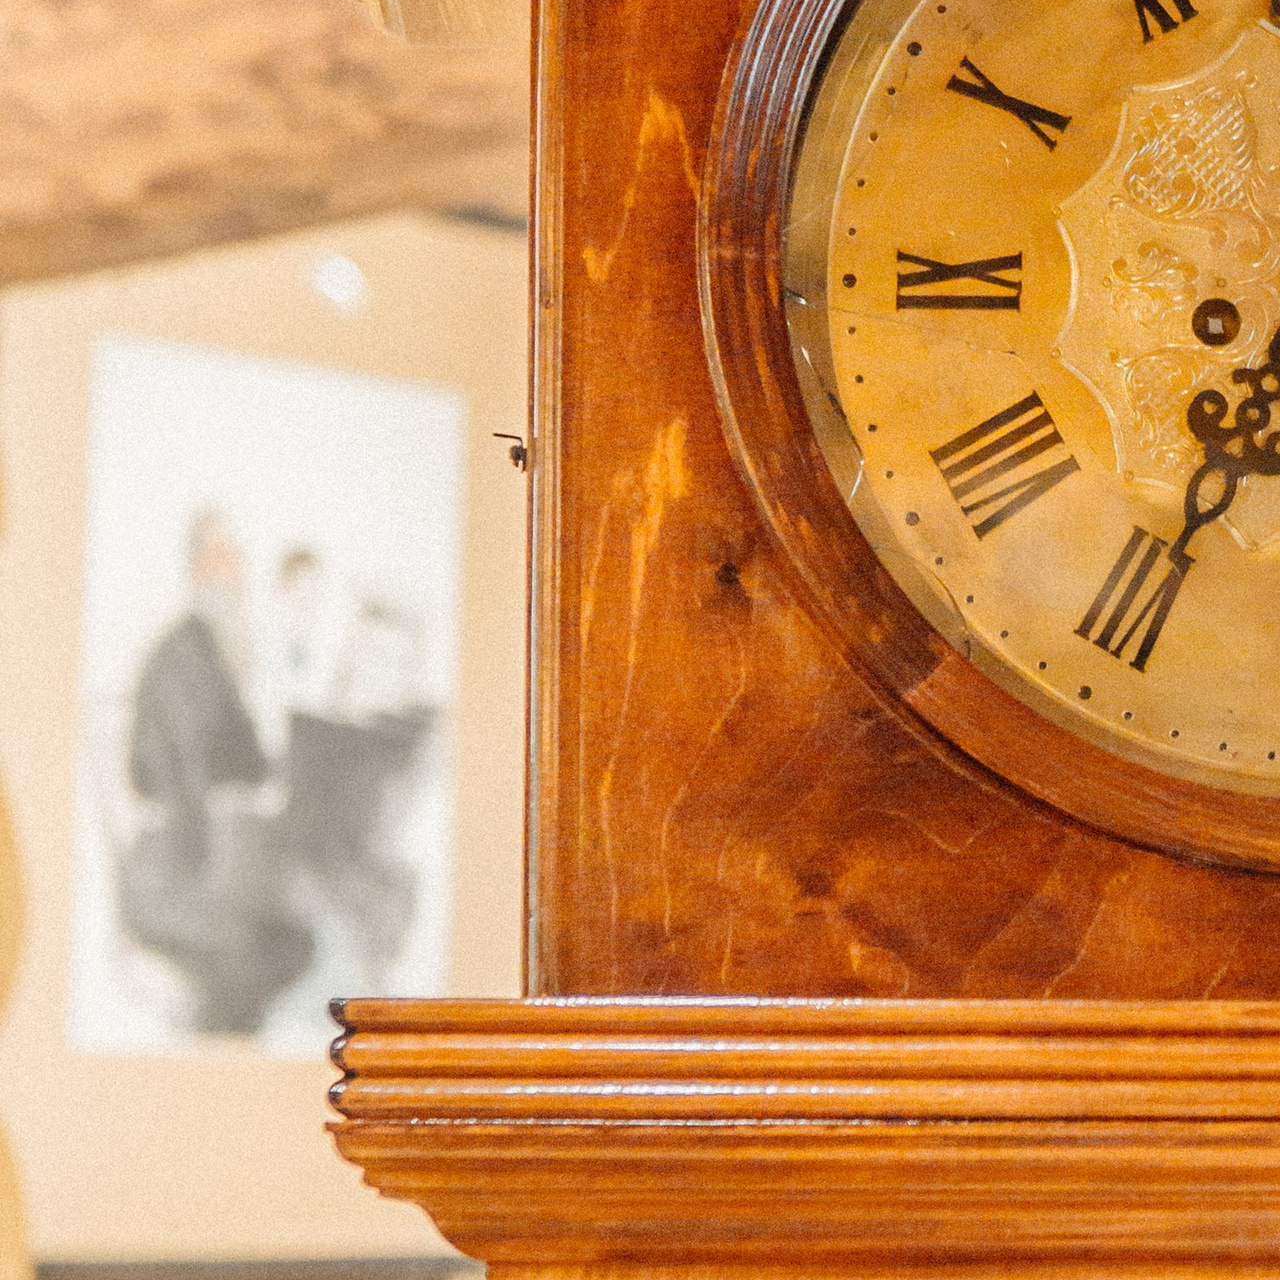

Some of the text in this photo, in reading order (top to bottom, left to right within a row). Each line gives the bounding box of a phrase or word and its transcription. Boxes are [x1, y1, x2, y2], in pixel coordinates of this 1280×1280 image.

[945, 57, 1072, 151] X
[896, 250, 1023, 311] IX
[929, 390, 1081, 540] VIII
[1073, 525, 1196, 673] VII
